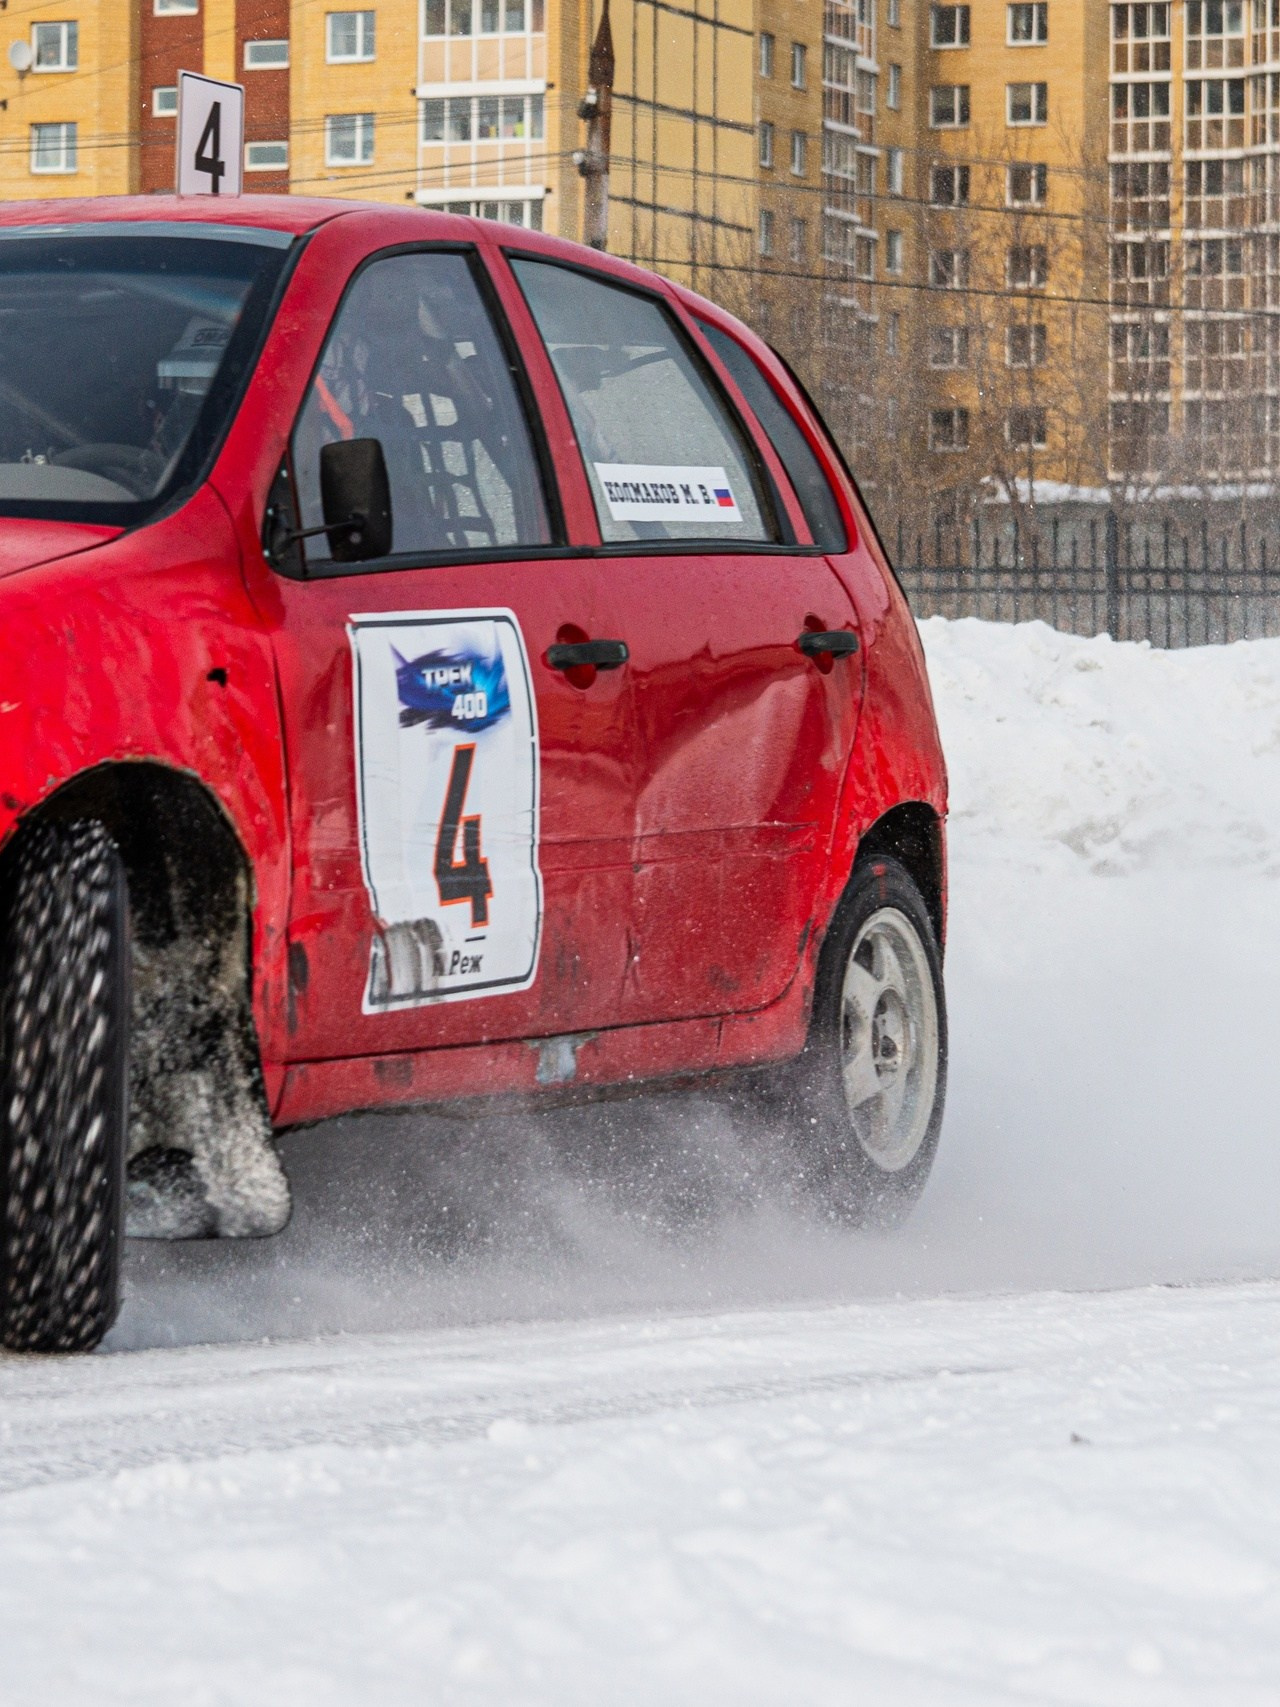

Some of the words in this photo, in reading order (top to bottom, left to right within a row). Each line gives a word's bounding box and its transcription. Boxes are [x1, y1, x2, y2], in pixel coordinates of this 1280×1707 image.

[195, 101, 225, 196] 4
[421, 663, 472, 688] ТРЕК
[451, 691, 487, 720] 400
[433, 742, 494, 929] 4
[448, 949, 484, 975] Реж
